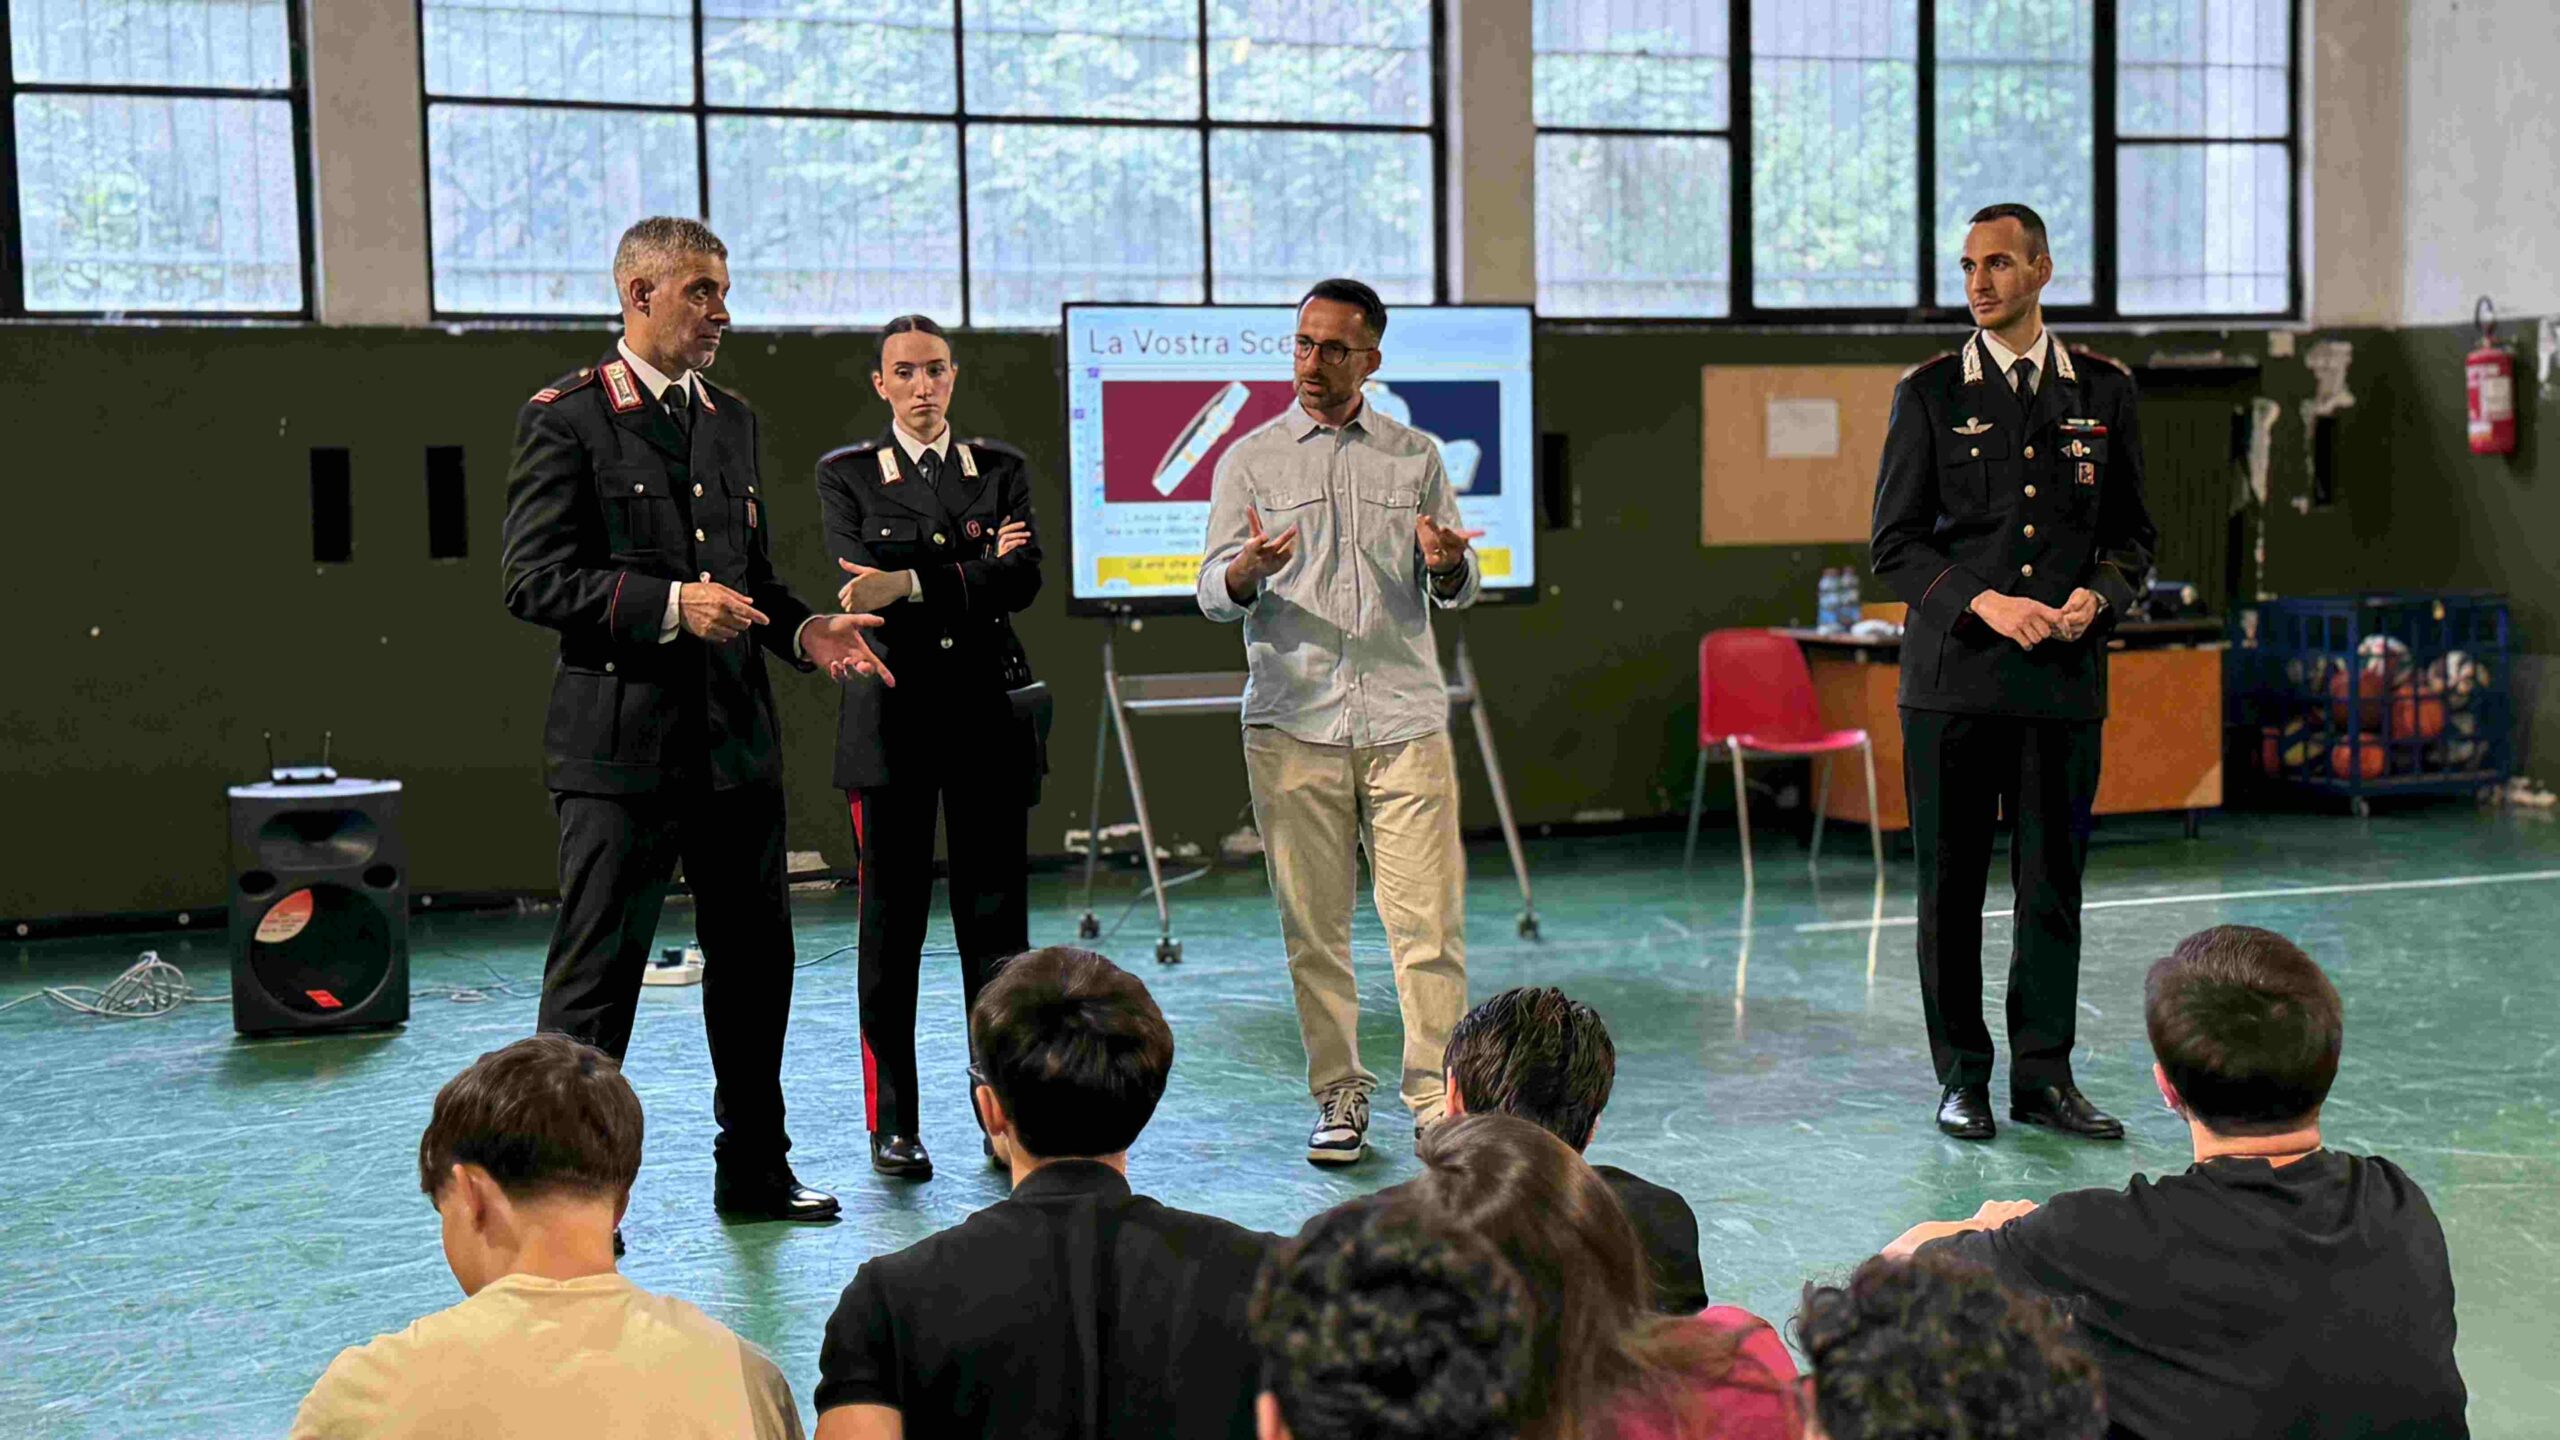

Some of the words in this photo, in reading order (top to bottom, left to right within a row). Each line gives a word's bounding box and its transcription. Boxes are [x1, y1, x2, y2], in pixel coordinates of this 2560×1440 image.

[1090, 329, 1122, 354] La
[1133, 329, 1229, 354] Vostra
[1240, 329, 1294, 354] Sce
